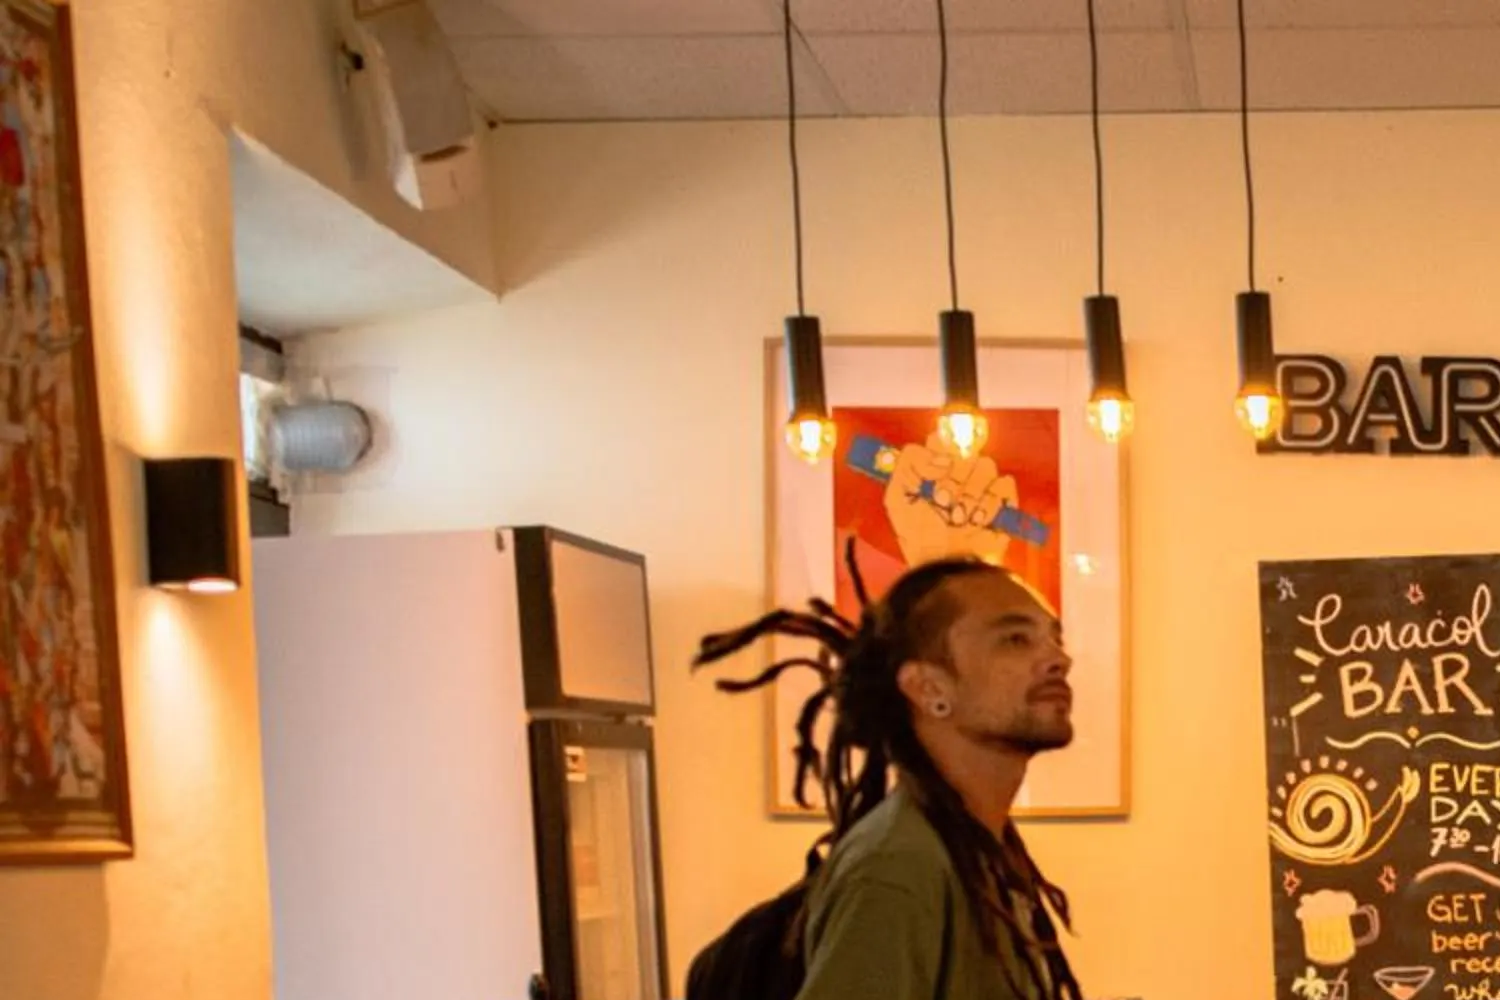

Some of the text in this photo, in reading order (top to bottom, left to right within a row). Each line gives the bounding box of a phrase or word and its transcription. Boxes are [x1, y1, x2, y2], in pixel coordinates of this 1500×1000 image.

[1297, 583, 1500, 657] Caracol
[1339, 653, 1495, 719] BAR
[1426, 893, 1487, 924] GET
[1431, 929, 1493, 953] beer
